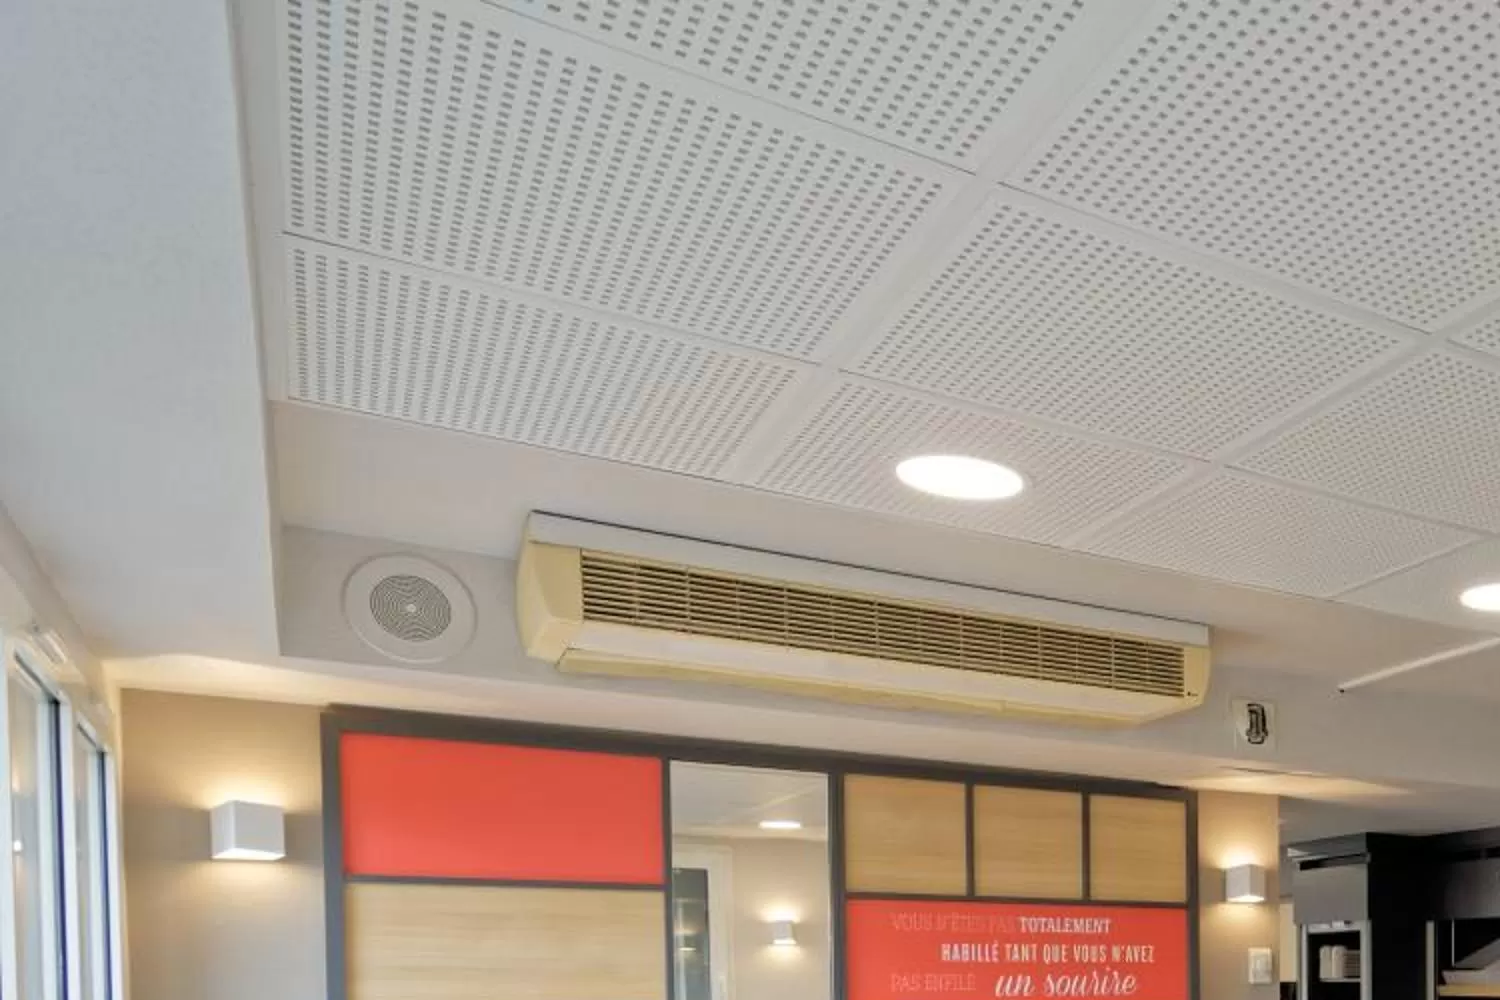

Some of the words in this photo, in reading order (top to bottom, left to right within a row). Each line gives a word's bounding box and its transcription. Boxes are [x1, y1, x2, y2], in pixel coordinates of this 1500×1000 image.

[1018, 915, 1111, 934] TOTALEMENT
[941, 940, 999, 963] HABILLÉ
[1004, 943, 1037, 963] TANT
[1042, 943, 1069, 965] QUE
[1073, 944, 1107, 963] VOUS
[1111, 944, 1155, 964] N'AVEZ
[994, 974, 1035, 997] un
[1044, 966, 1137, 997] sourire
